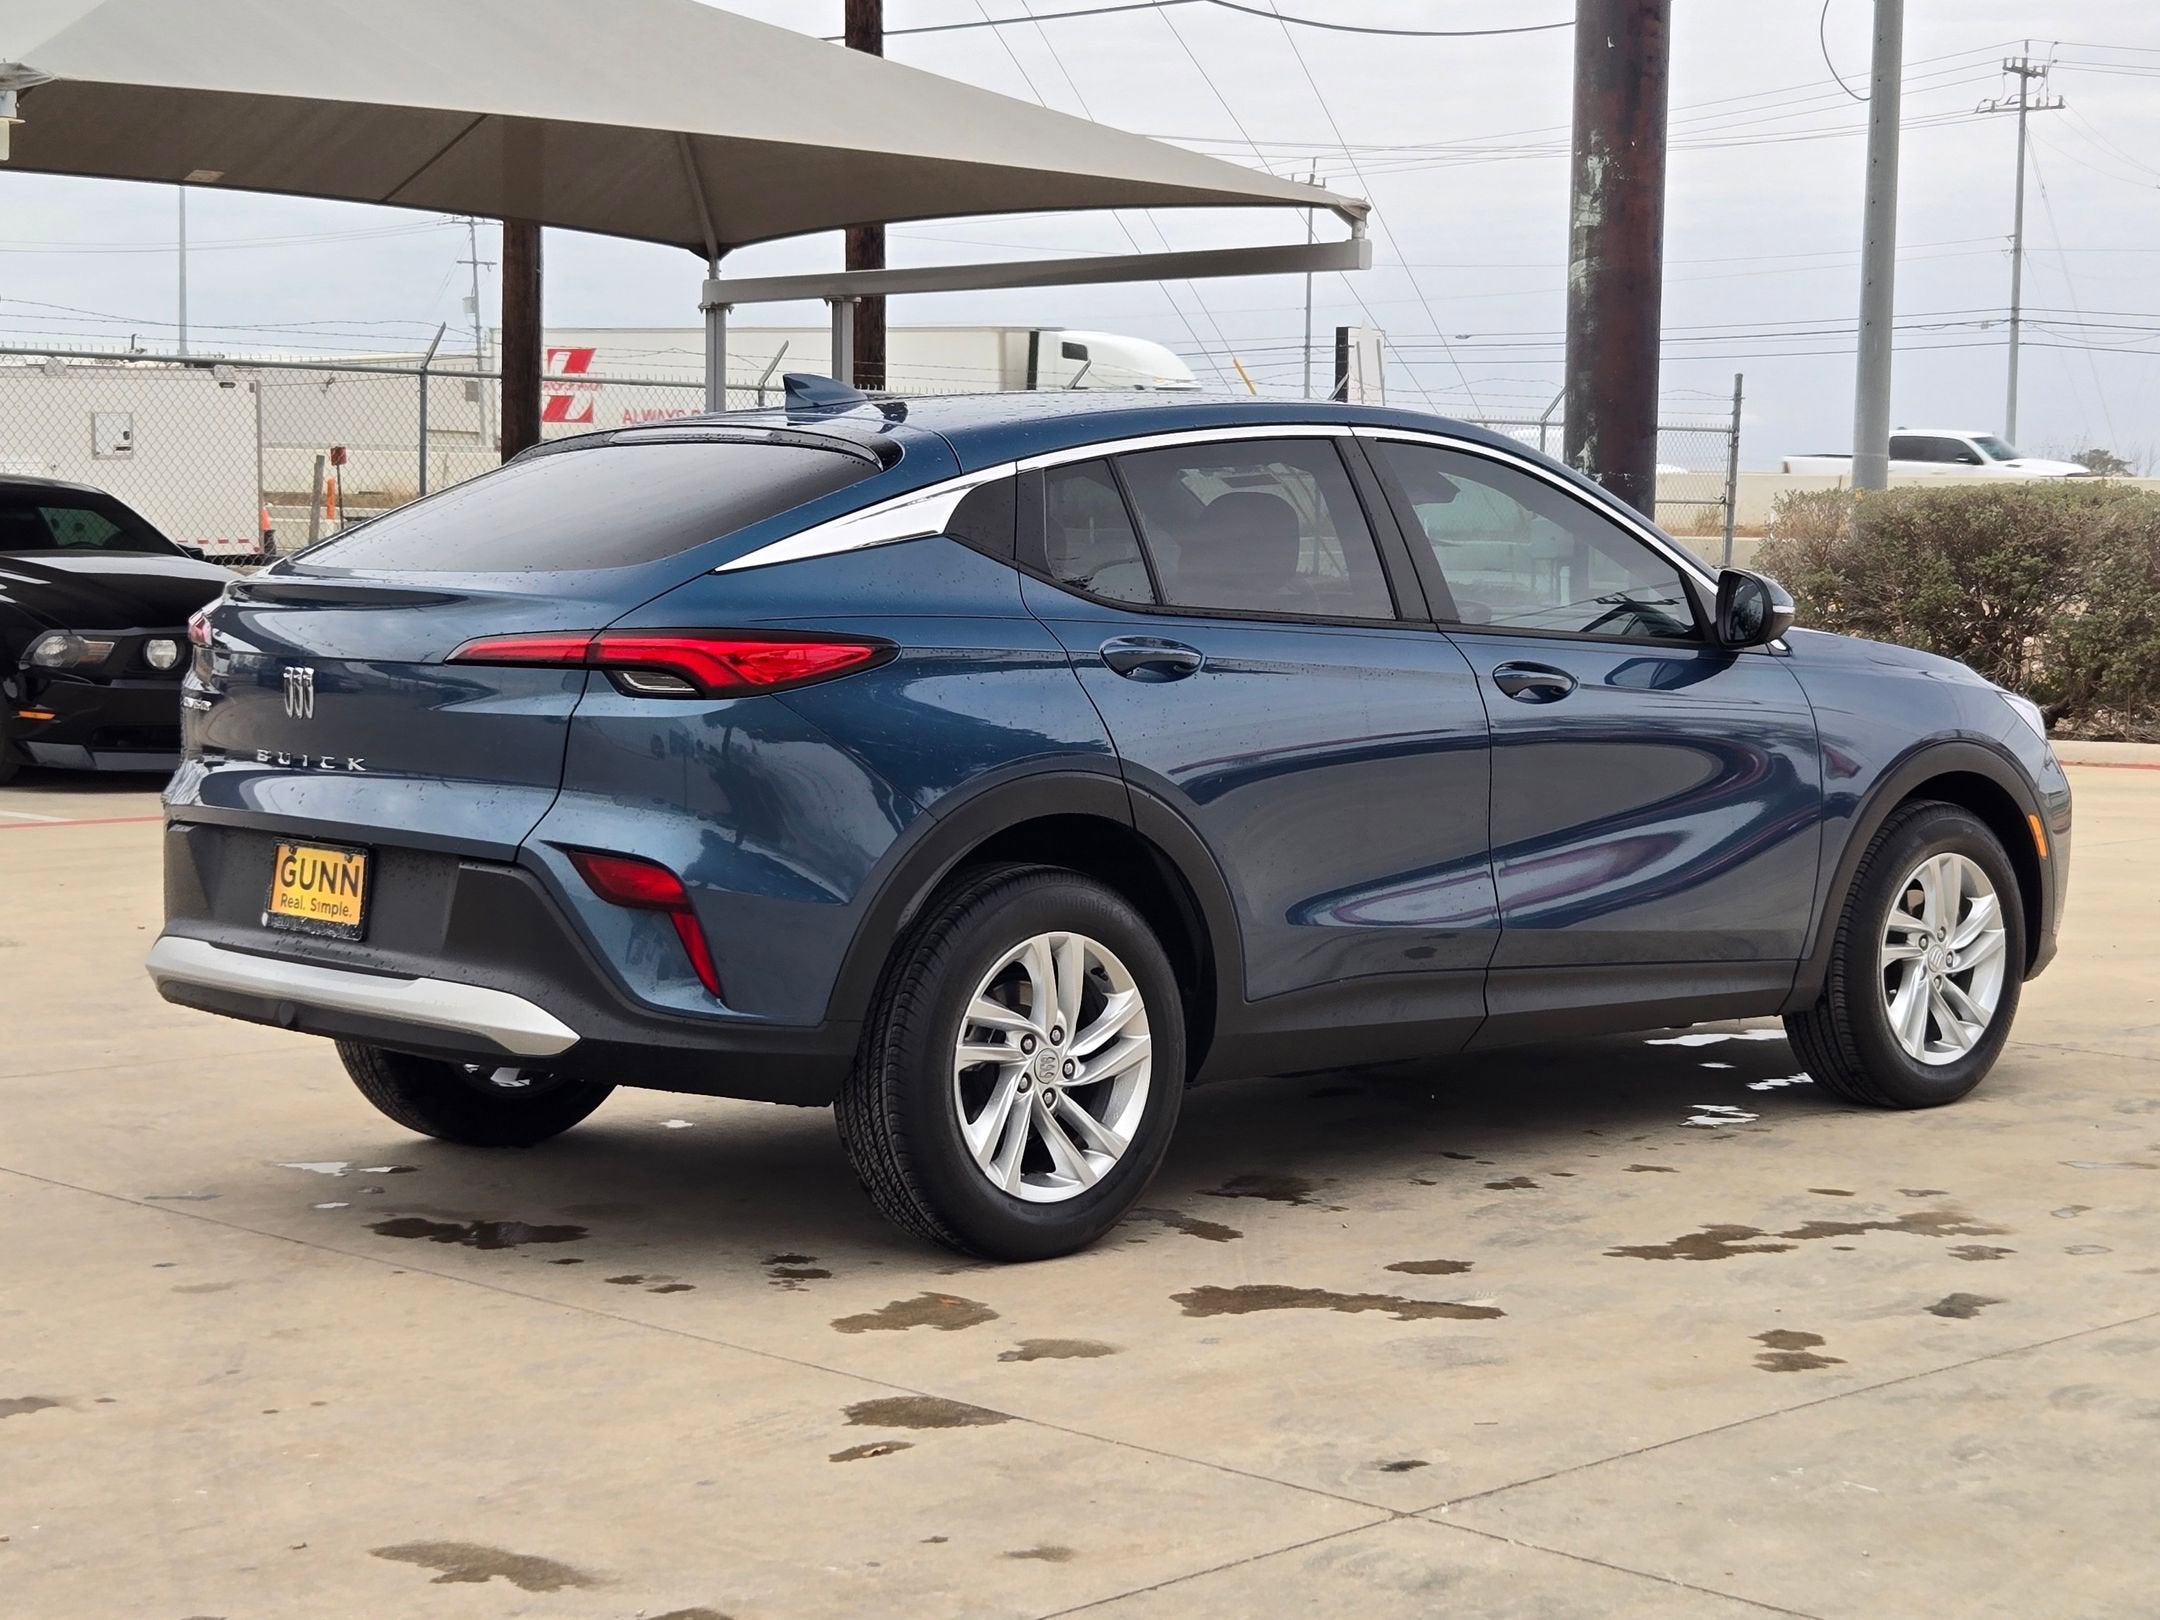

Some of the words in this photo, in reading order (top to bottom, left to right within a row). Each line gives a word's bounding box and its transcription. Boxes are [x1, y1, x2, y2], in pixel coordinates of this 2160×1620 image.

[257, 749, 366, 770] BUICK
[281, 855, 360, 897] GUNN
[280, 893, 306, 911] Real.
[310, 898, 352, 918] Simple.
